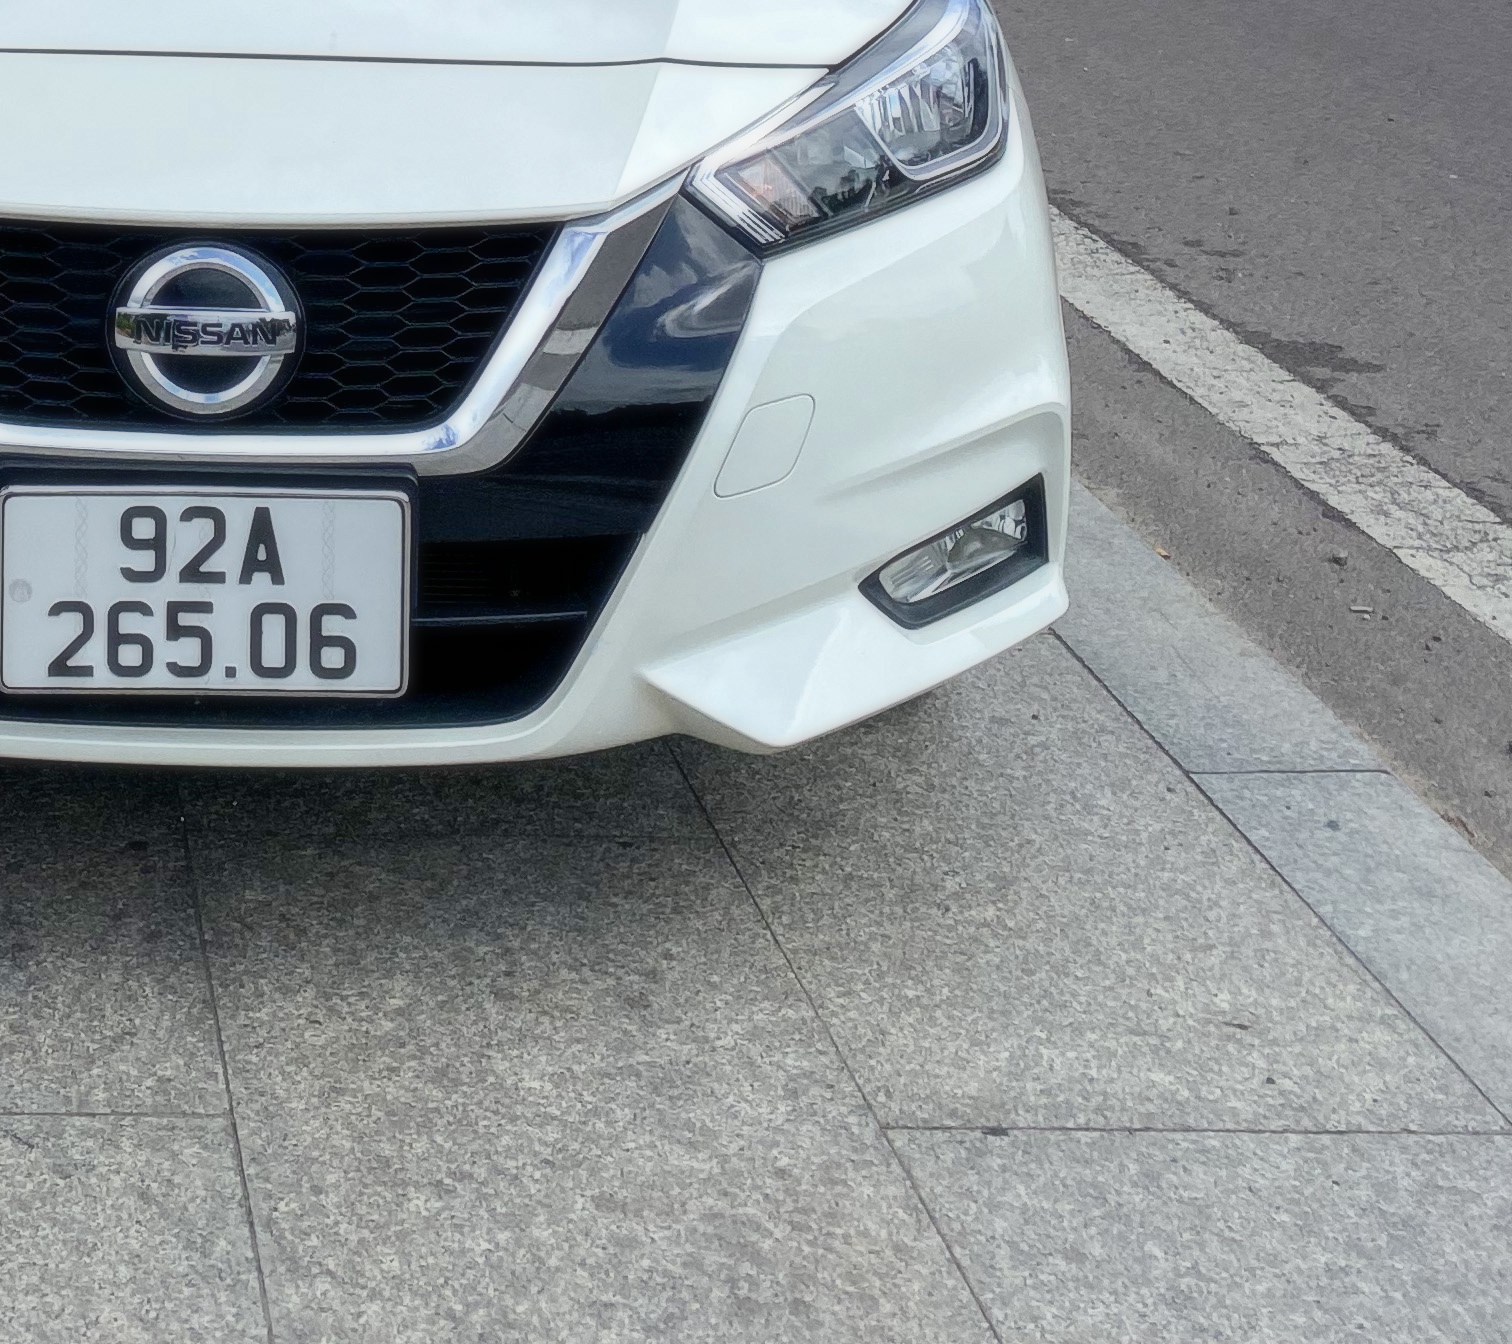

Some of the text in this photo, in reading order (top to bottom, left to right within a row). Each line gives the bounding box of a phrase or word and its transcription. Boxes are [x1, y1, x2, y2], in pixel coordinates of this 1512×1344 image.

[134, 316, 277, 347] NISSAN
[118, 505, 286, 586] 92A
[46, 600, 358, 680] 265.06
